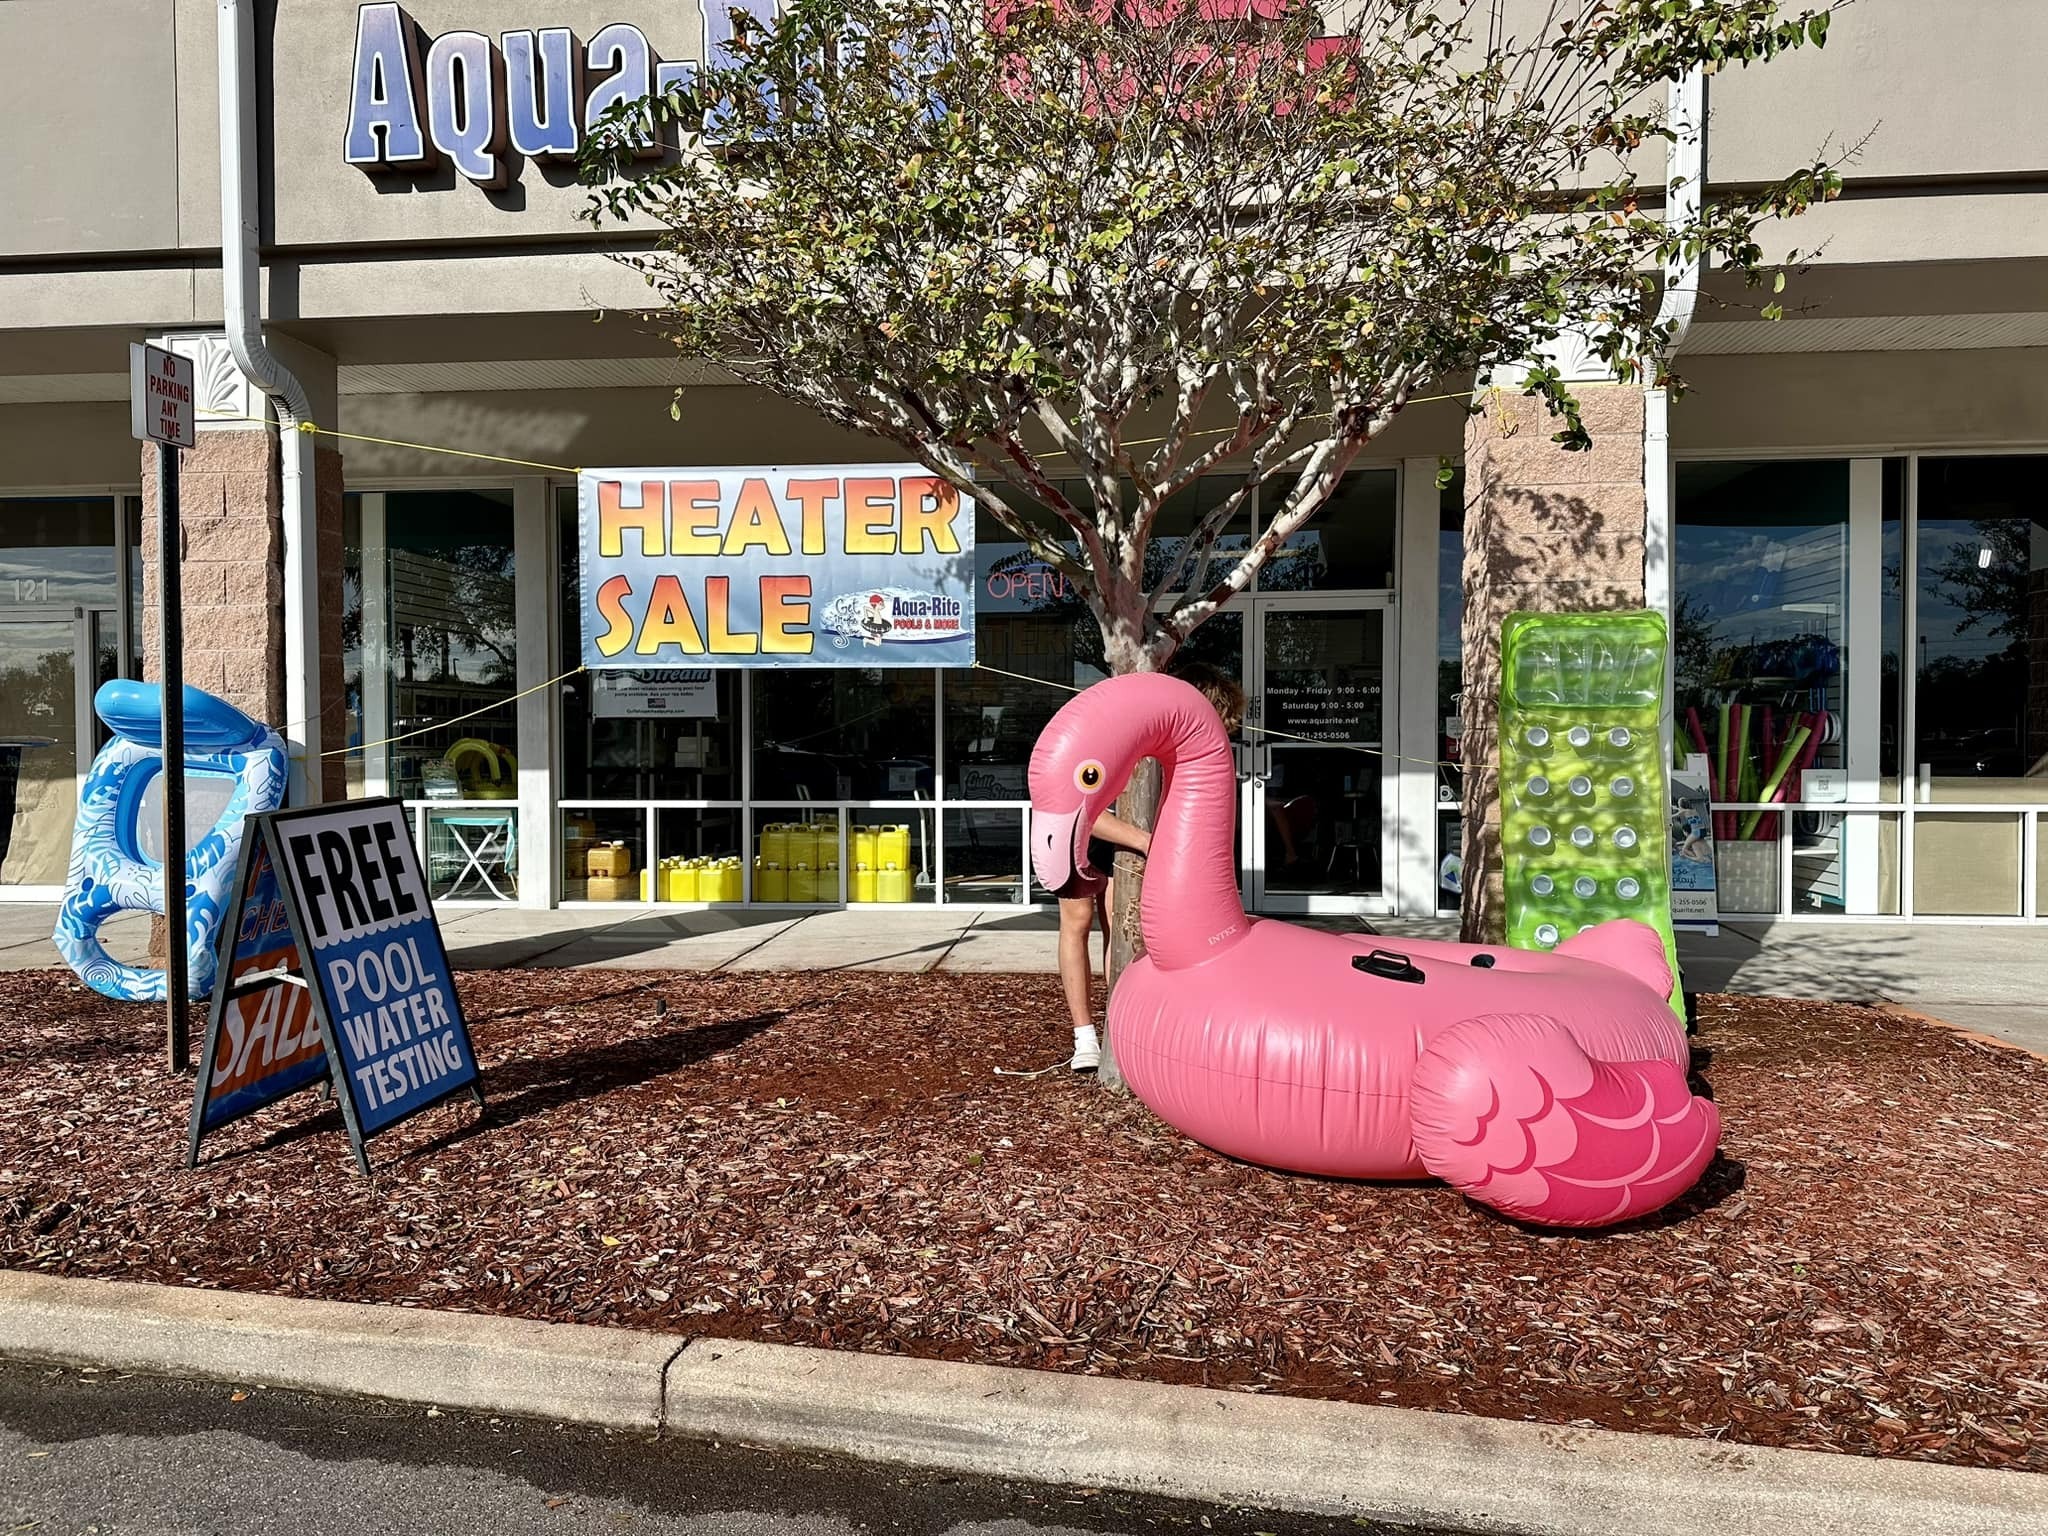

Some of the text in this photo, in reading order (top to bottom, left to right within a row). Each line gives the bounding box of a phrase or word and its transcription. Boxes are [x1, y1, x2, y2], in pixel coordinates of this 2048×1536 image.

[163, 357, 176, 378] NO
[150, 374, 189, 403] PARKING
[161, 399, 178, 419] ANY
[160, 418, 181, 439] TIME
[597, 475, 962, 557] HEATER
[15, 579, 48, 601] 121
[987, 569, 1064, 599] OPEN
[594, 574, 814, 658] SALE
[892, 597, 961, 617] Aqua-Rite
[1266, 687, 1299, 696] Monday
[1306, 687, 1333, 696] Friday
[1337, 686, 1355, 695] 9:00
[1362, 686, 1381, 695] 6:00
[1282, 702, 1319, 711] Saturday
[1321, 702, 1339, 710] 9:00
[1346, 702, 1365, 710] 5:00
[1287, 717, 1360, 725] www.aquarite.net
[991, 782, 1028, 800] Strea
[289, 821, 417, 938] FREE
[238, 900, 291, 944] CHE
[328, 937, 435, 1014] POOL
[342, 987, 449, 1062] WATER
[355, 1030, 463, 1111] TESTING
